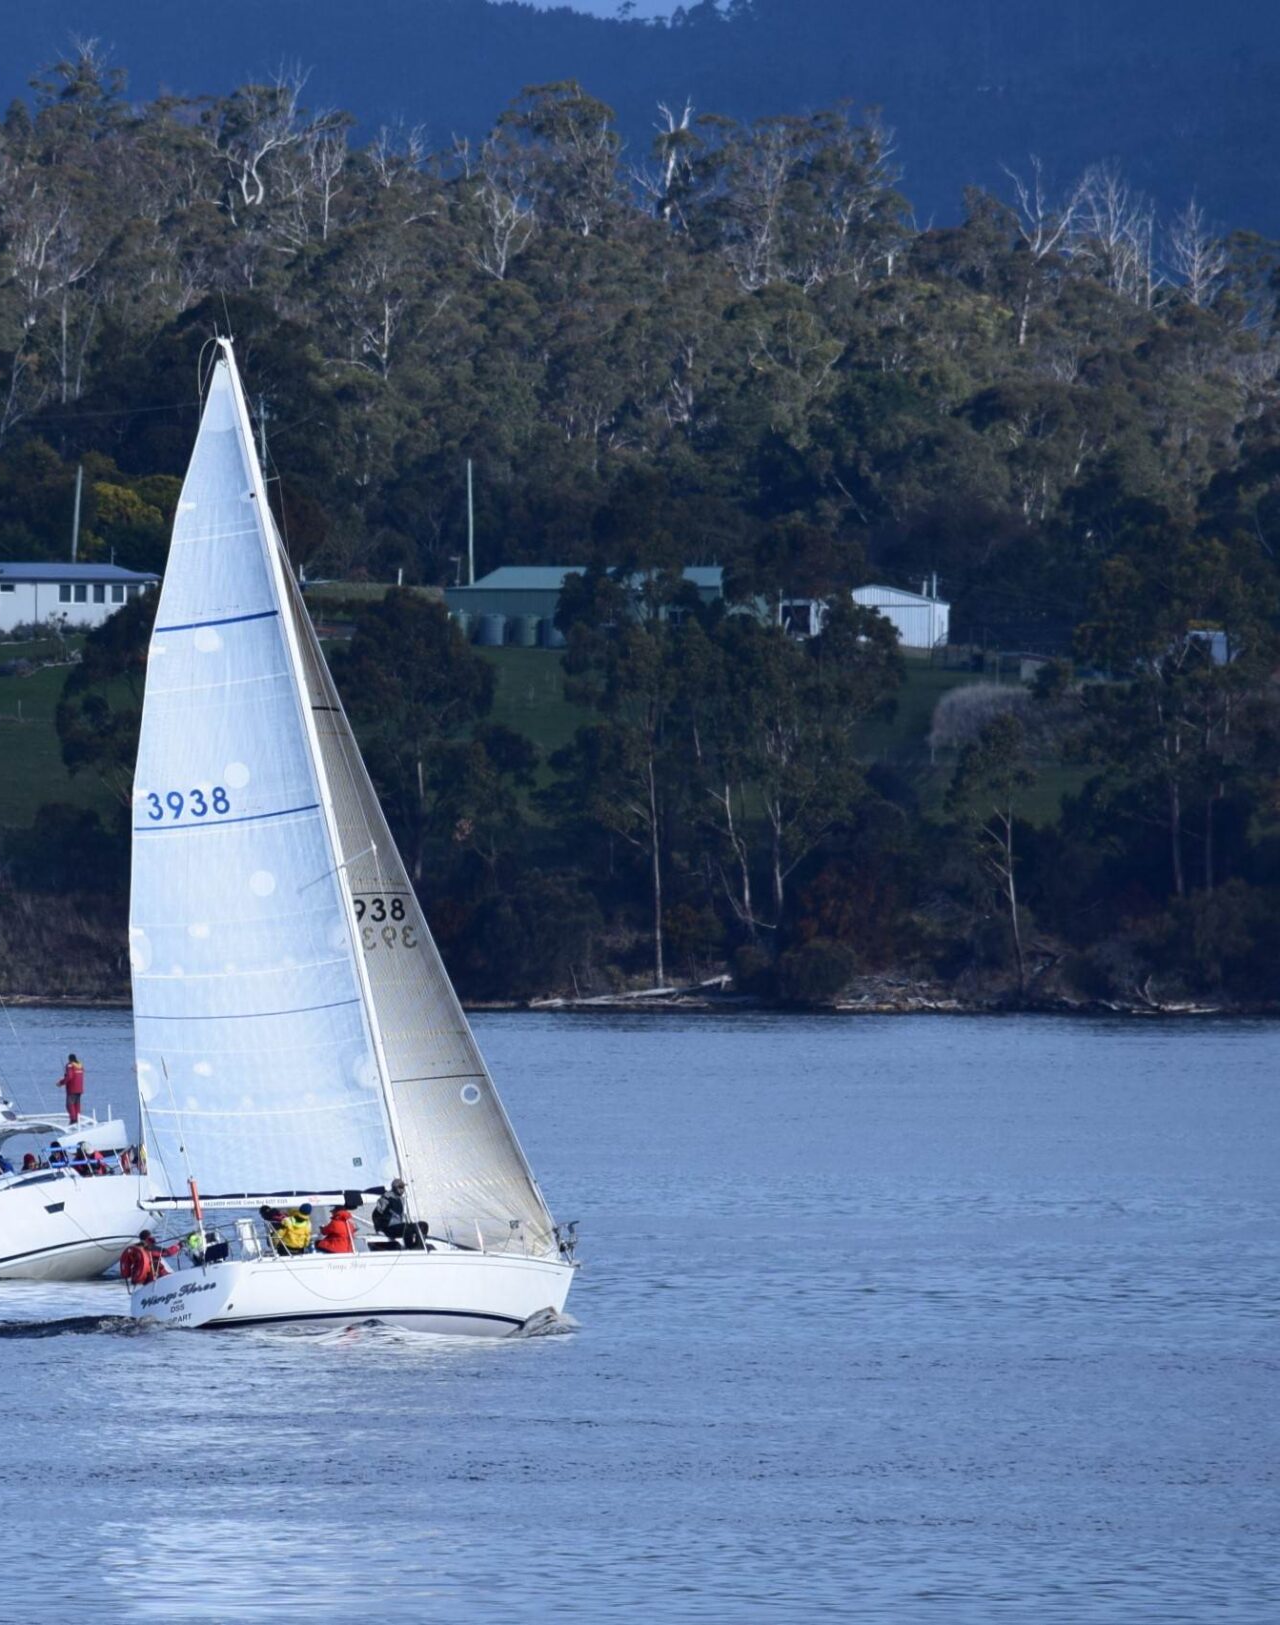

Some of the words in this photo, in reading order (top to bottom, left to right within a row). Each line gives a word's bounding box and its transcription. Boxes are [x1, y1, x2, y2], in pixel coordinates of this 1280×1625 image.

[147, 786, 230, 821] 3938
[353, 898, 405, 922] 938
[140, 1292, 177, 1309] Wings
[178, 1282, 217, 1297] Three
